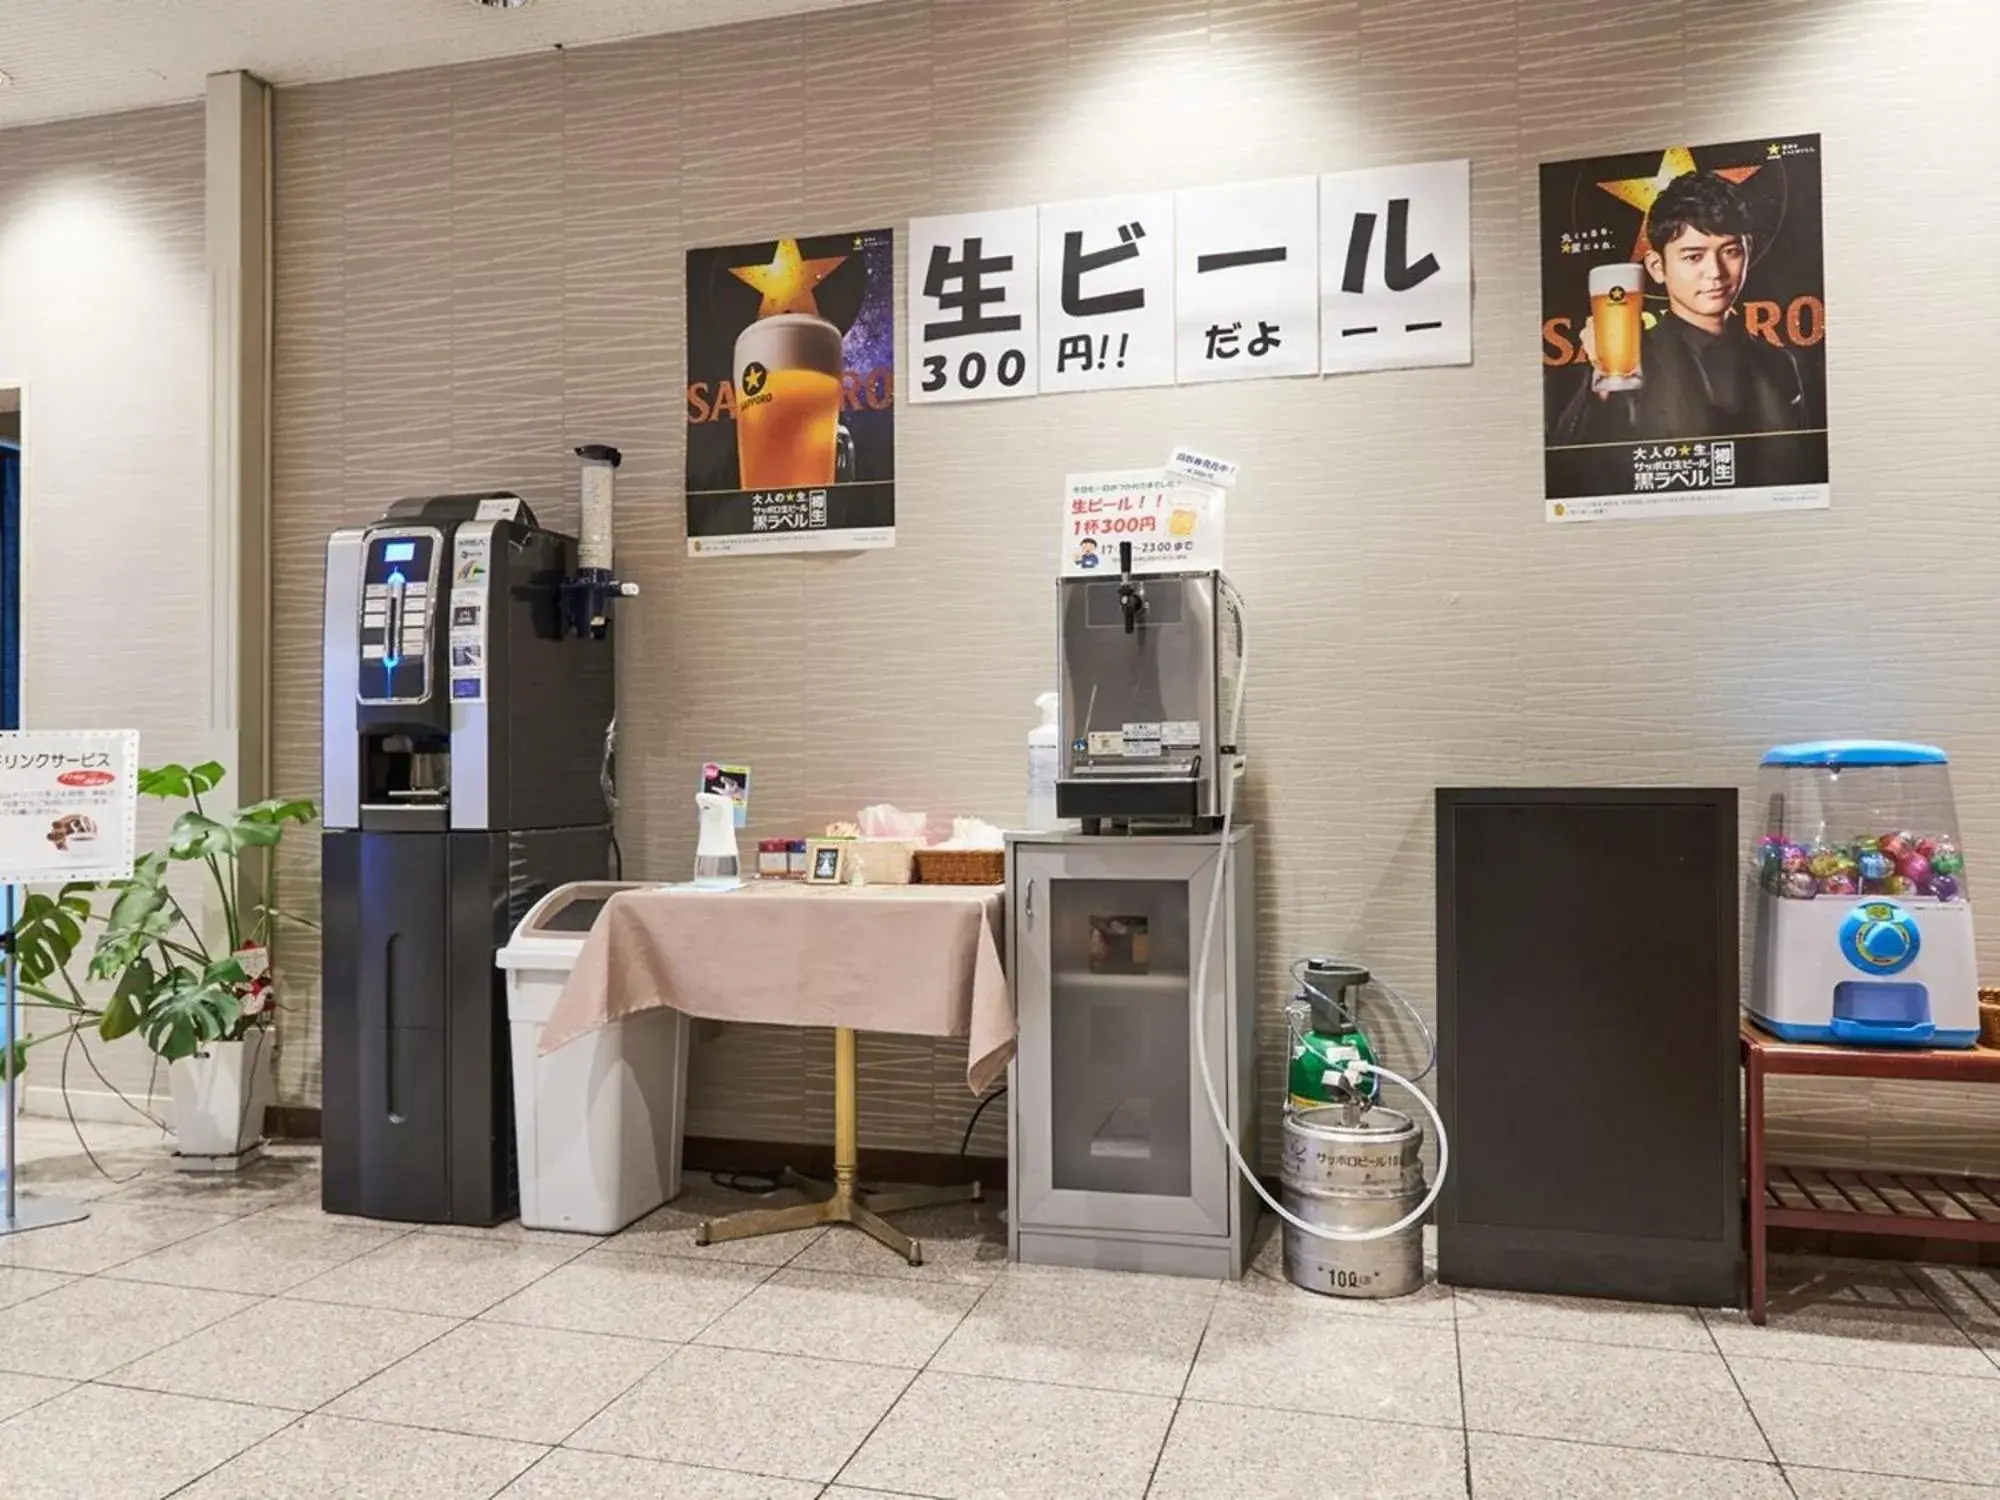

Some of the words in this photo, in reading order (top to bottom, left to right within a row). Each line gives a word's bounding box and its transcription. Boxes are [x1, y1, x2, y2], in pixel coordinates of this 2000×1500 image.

[1633, 469, 1710, 491] 黒ラベル
[752, 512, 809, 531] 黒ラベル
[0, 752, 111, 770] リンクサービス
